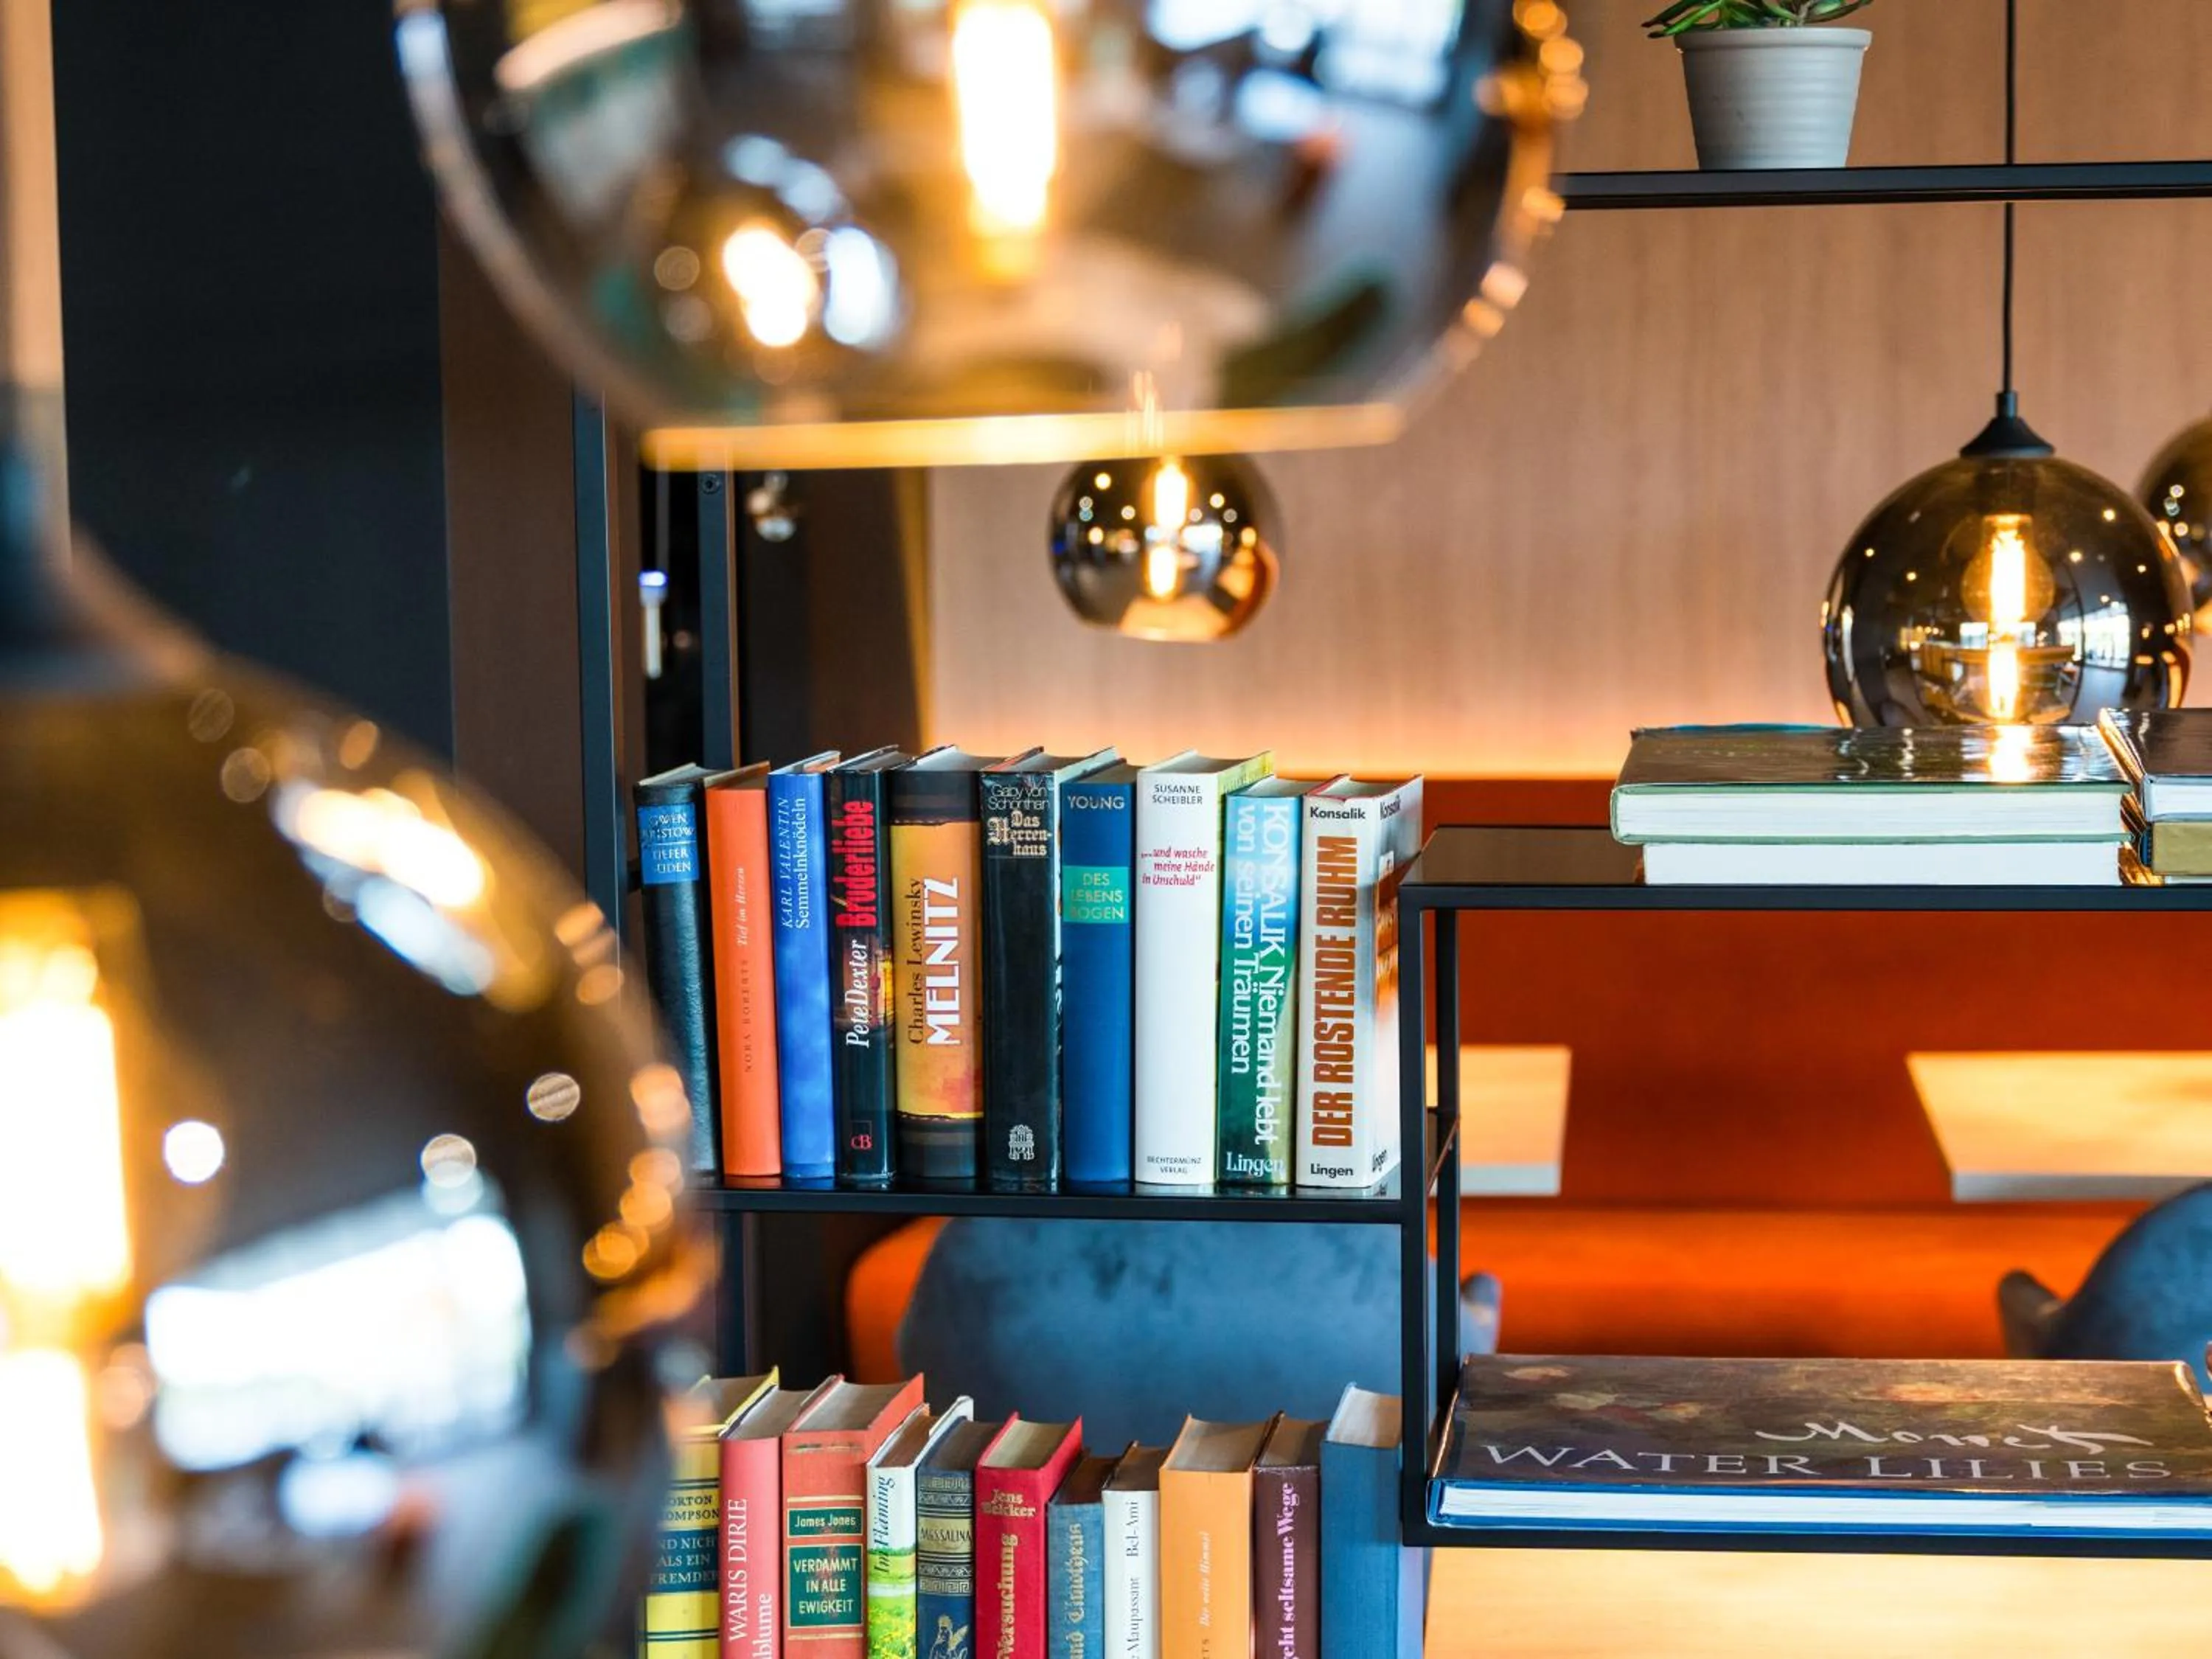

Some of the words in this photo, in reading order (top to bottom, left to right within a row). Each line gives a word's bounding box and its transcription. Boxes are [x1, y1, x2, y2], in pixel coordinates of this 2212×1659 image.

[992, 784, 1023, 799] Gaby
[1067, 795, 1125, 810] YOUNG
[1152, 794, 1203, 804] SCHEIBLER
[1154, 784, 1201, 794] SUSANNE
[1011, 810, 1040, 827] Das
[1237, 804, 1255, 852] von
[1310, 807, 1366, 820] Konsalik
[779, 797, 791, 880] VALENTIN
[1012, 839, 1047, 856] haus
[791, 798, 810, 929] Semmelnknödeln
[1083, 873, 1110, 886] DES
[1141, 874, 1151, 885] in
[1154, 861, 1182, 872] meine
[1258, 804, 1290, 957] KONSALIK
[1071, 889, 1123, 902] LEBENS
[1316, 836, 1357, 928] RUHM
[781, 887, 793, 928] KARL
[1234, 860, 1260, 949] seinen
[905, 878, 923, 966] Lewinsky
[924, 876, 961, 1046] MELNITZ
[907, 973, 924, 1044] Charles
[1231, 952, 1260, 1074] Träumen
[1313, 934, 1357, 1083] ROSTENDE
[1256, 964, 1286, 1088] Niemand
[1255, 1096, 1281, 1145] lebt
[1312, 1091, 1354, 1147] DER
[1226, 1152, 1285, 1177] Lingen
[1310, 1163, 1354, 1179] Lingen
[1755, 1421, 2155, 1455] Monet
[1483, 1444, 1822, 1475] WATER
[1863, 1455, 2172, 1480] LILIES
[666, 1495, 713, 1506] ORTON
[667, 1508, 720, 1521] OMPSON
[1277, 1483, 1300, 1536] Wege
[728, 1498, 748, 1562] DIRIE
[794, 1515, 826, 1528] James
[827, 1513, 856, 1527] Jones
[1126, 1500, 1139, 1557] Bel-Ami
[681, 1534, 716, 1549] NICH
[650, 1571, 717, 1585] FREMDE
[793, 1558, 858, 1573] VERDAMMT
[1278, 1537, 1295, 1621] seltsame
[806, 1579, 819, 1593] IN
[821, 1579, 846, 1593] ALLE
[728, 1569, 748, 1642] WARIS
[799, 1599, 855, 1614] EWIGKEIT
[751, 1593, 773, 1659] blume
[1278, 1627, 1295, 1659] eht
